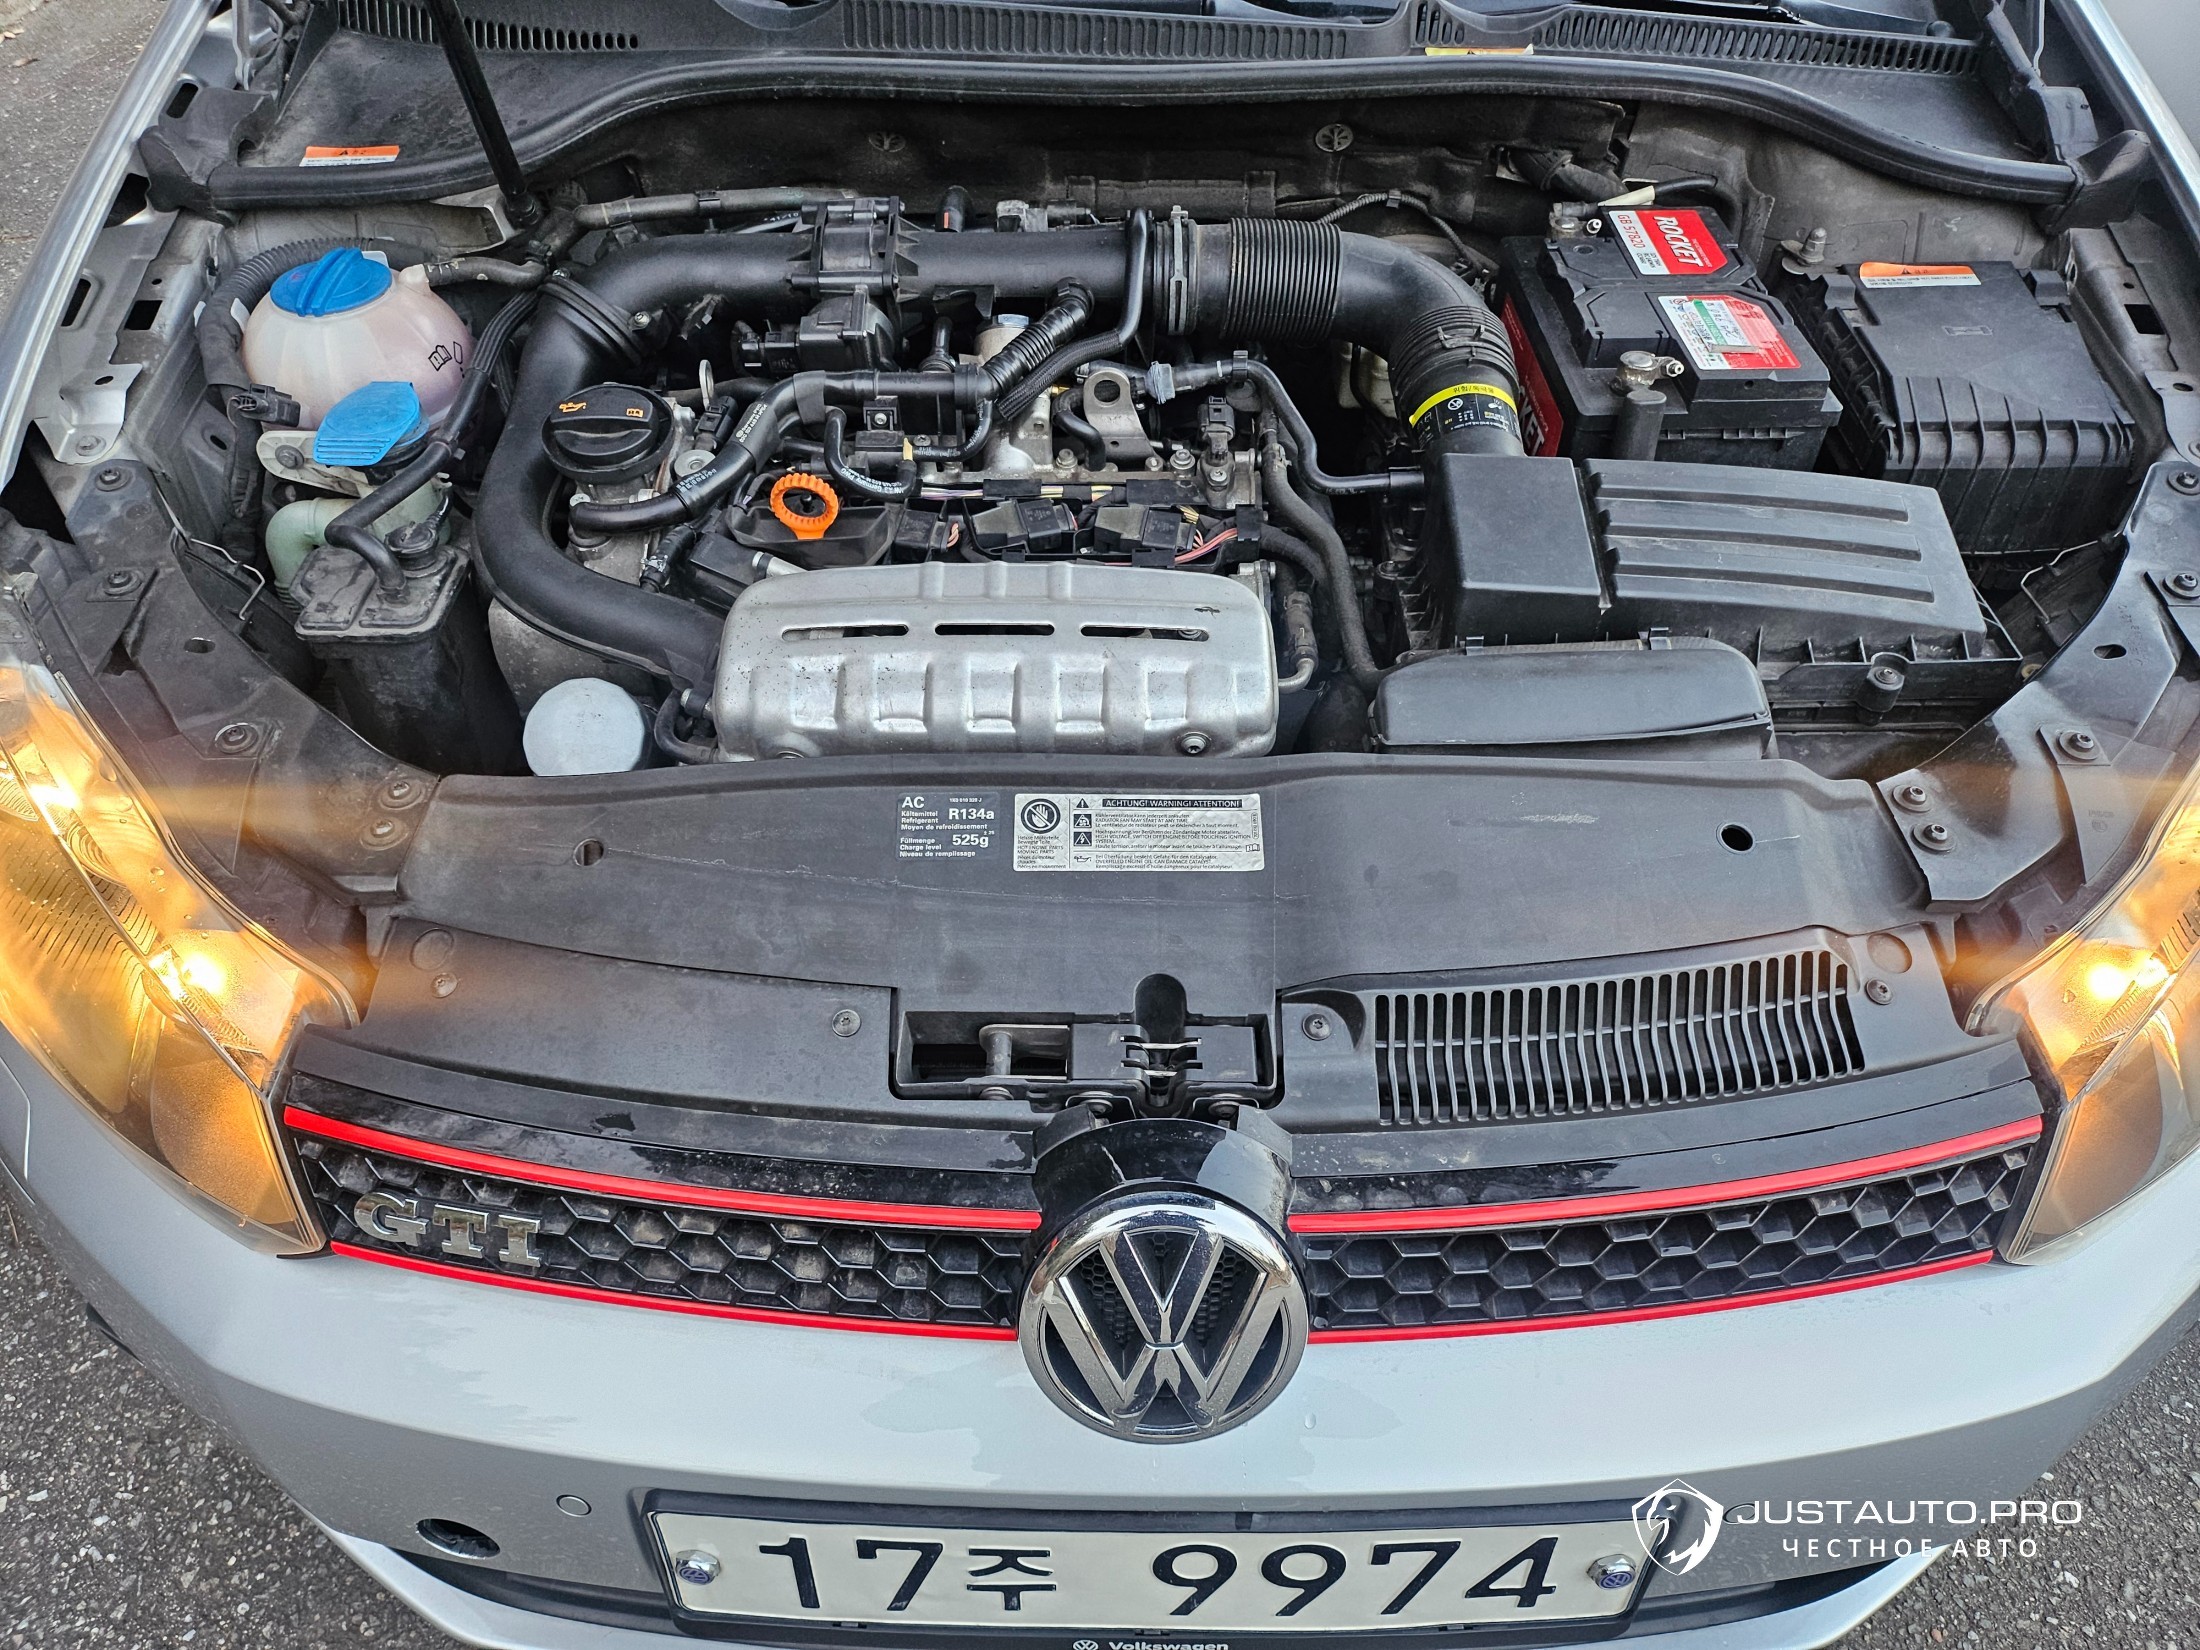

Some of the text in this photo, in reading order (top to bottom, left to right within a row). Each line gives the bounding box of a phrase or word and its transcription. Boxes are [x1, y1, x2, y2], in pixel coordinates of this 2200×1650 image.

[1617, 214, 1646, 249] GB 57820
[1653, 215, 1704, 267] ROCKET
[901, 796, 925, 809] AC
[1105, 799, 1148, 807] ACHTUNG!
[1149, 800, 1192, 808] WARNING!
[948, 808, 995, 820] R134a
[900, 837, 936, 845] Füllmenge
[952, 833, 989, 848] 525g
[935, 850, 976, 858] remplissage
[353, 1191, 541, 1268] GTI
[1028, 1200, 1300, 1439] VW
[758, 1536, 1559, 1617] 17주 9974
[1108, 1641, 1229, 1650] Volkswagen
